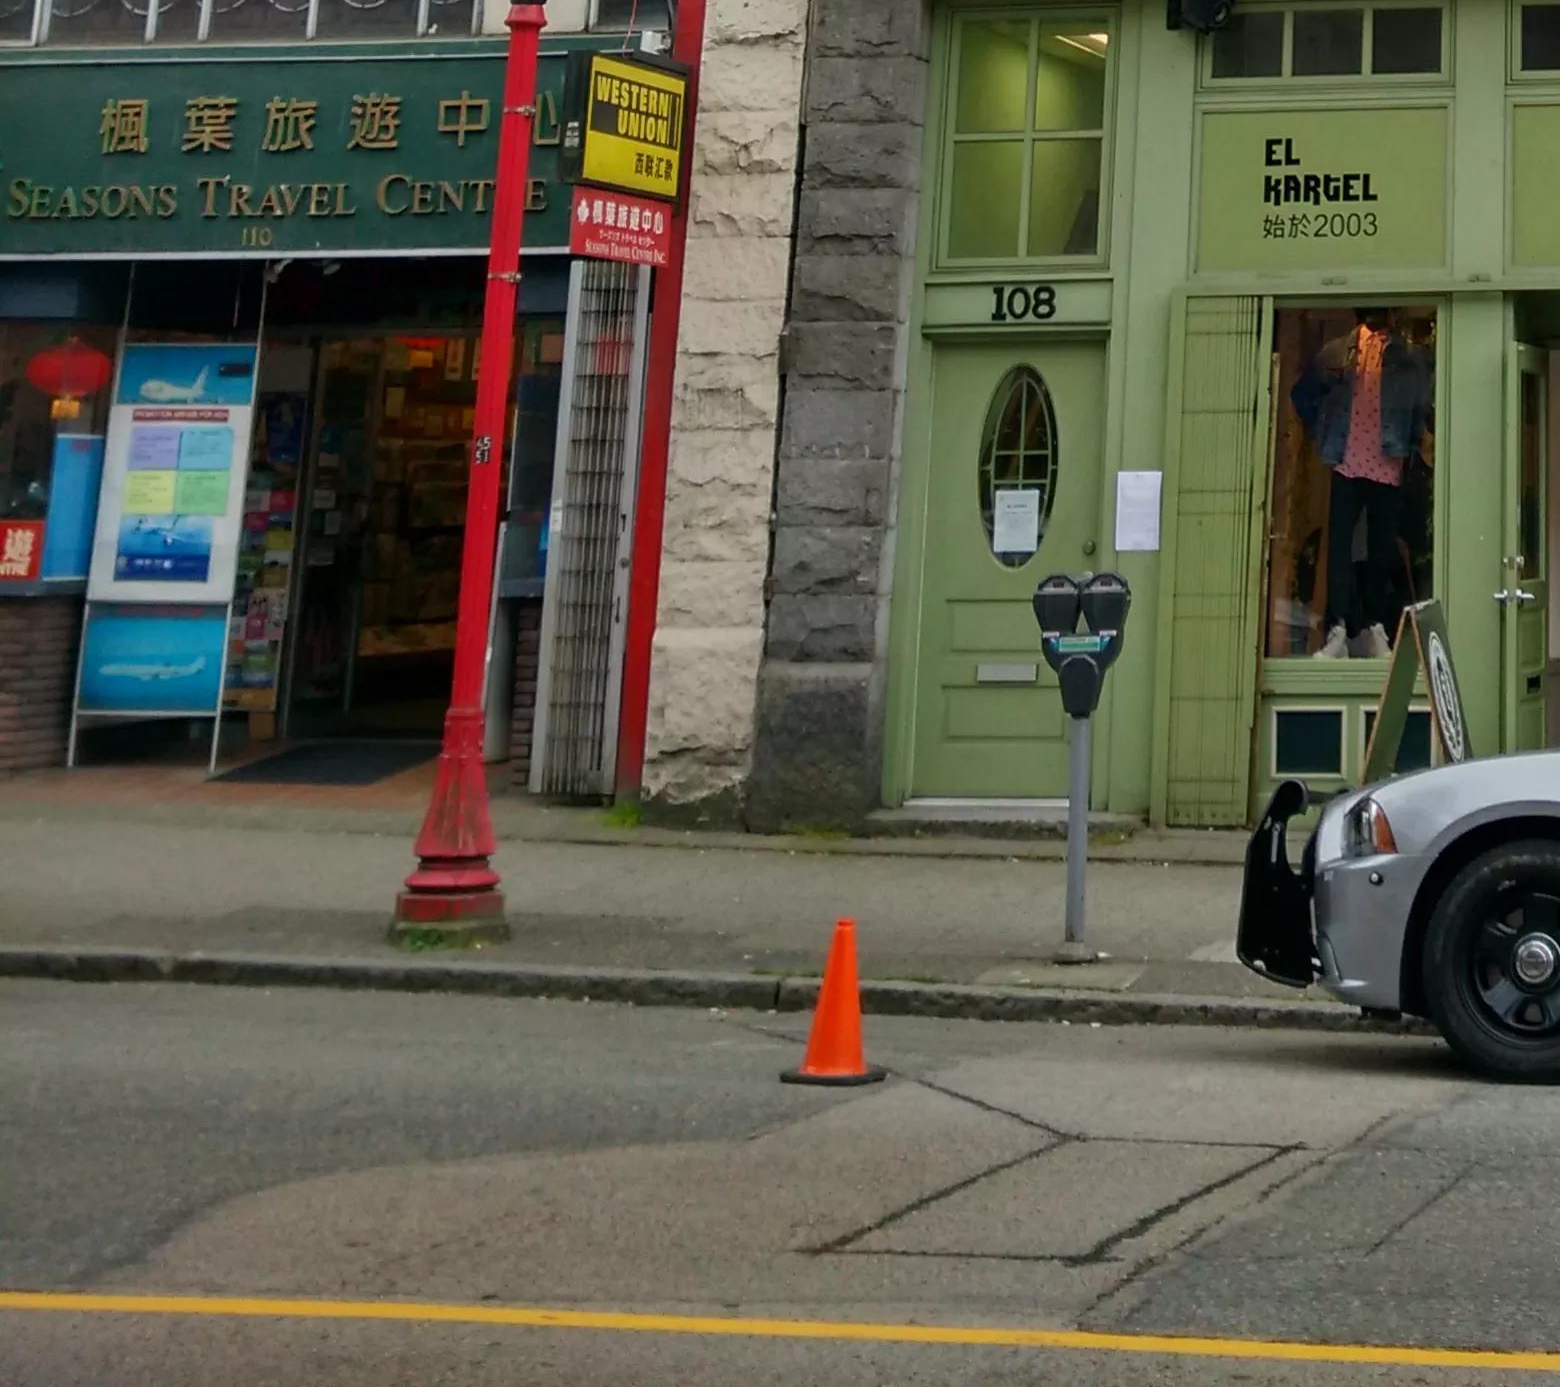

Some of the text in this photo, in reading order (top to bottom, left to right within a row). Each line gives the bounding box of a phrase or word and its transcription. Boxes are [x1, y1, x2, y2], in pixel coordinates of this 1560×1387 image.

[597, 74, 669, 117] WESTERN
[618, 108, 668, 144] UNION
[1265, 138, 1300, 166] EL
[8, 174, 548, 221] SEASONS TRAVEL CENTE
[241, 227, 273, 246] 110
[992, 285, 1057, 322] 108
